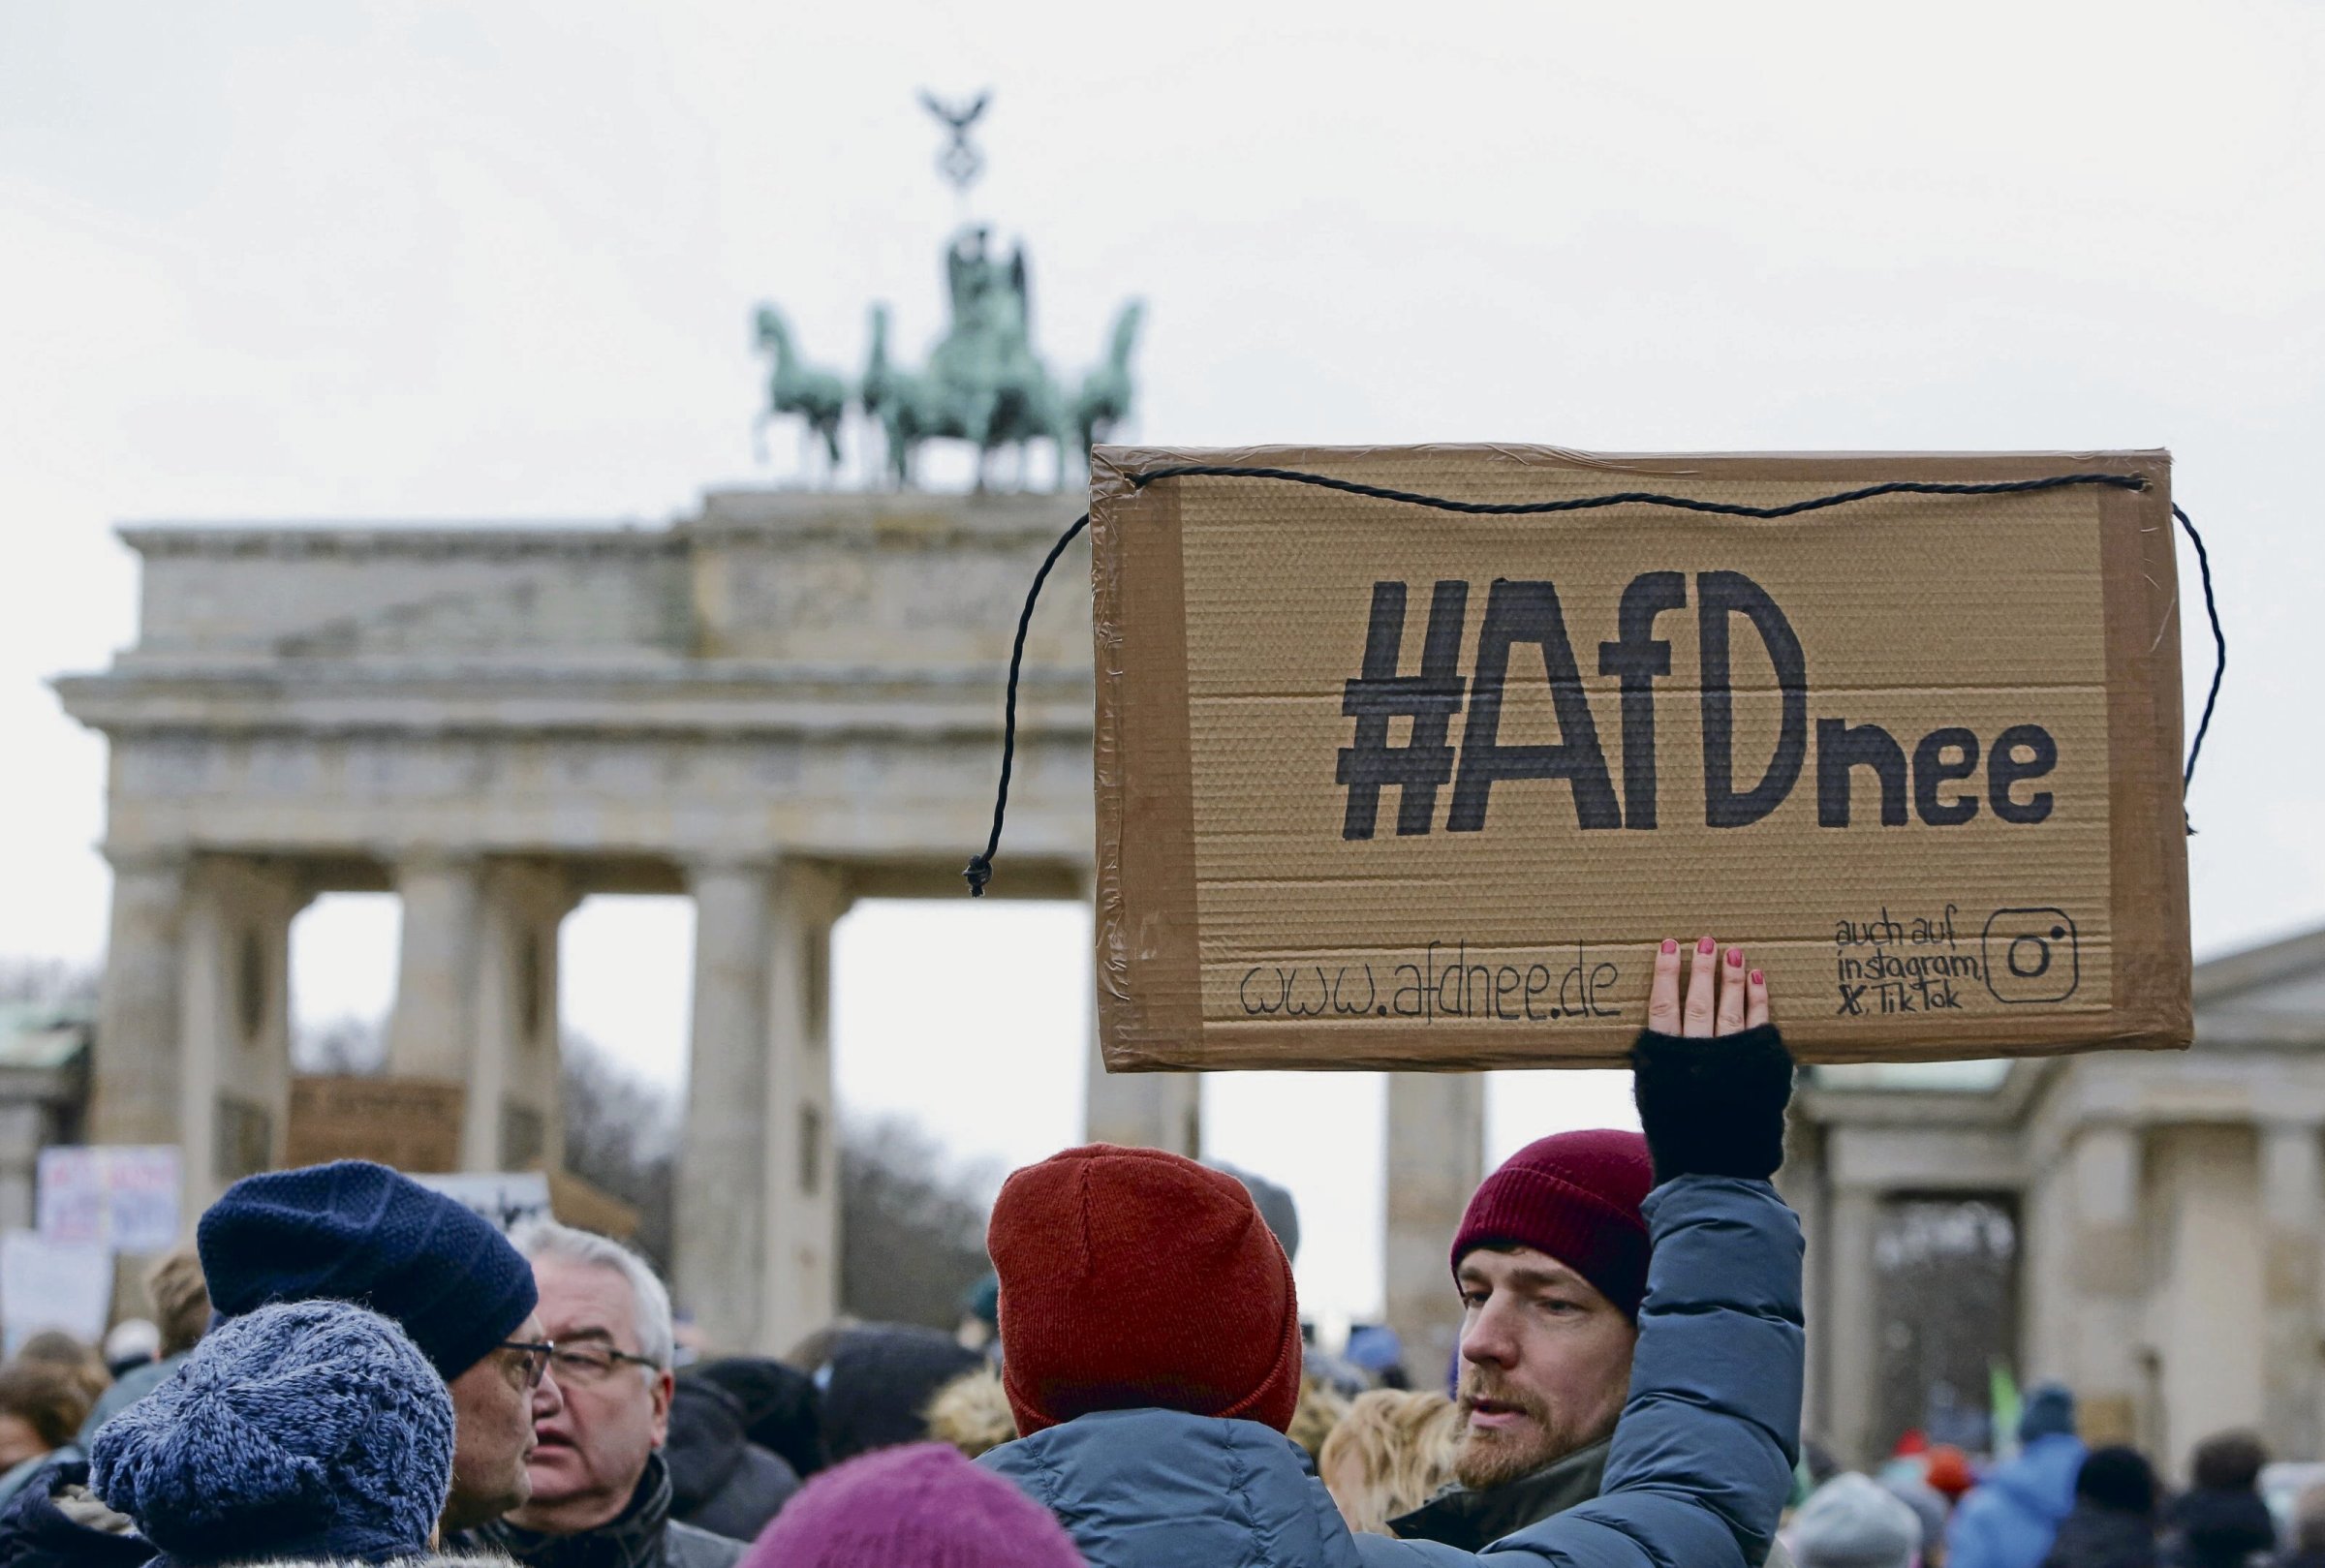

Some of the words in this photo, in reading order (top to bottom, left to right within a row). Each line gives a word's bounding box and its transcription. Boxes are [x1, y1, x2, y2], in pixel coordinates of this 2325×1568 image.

[1336, 569, 2059, 842] #AfDnee
[1836, 906, 1903, 946] auch
[1911, 903, 1958, 951] auf
[1240, 938, 1622, 1025] www.afdnee.de
